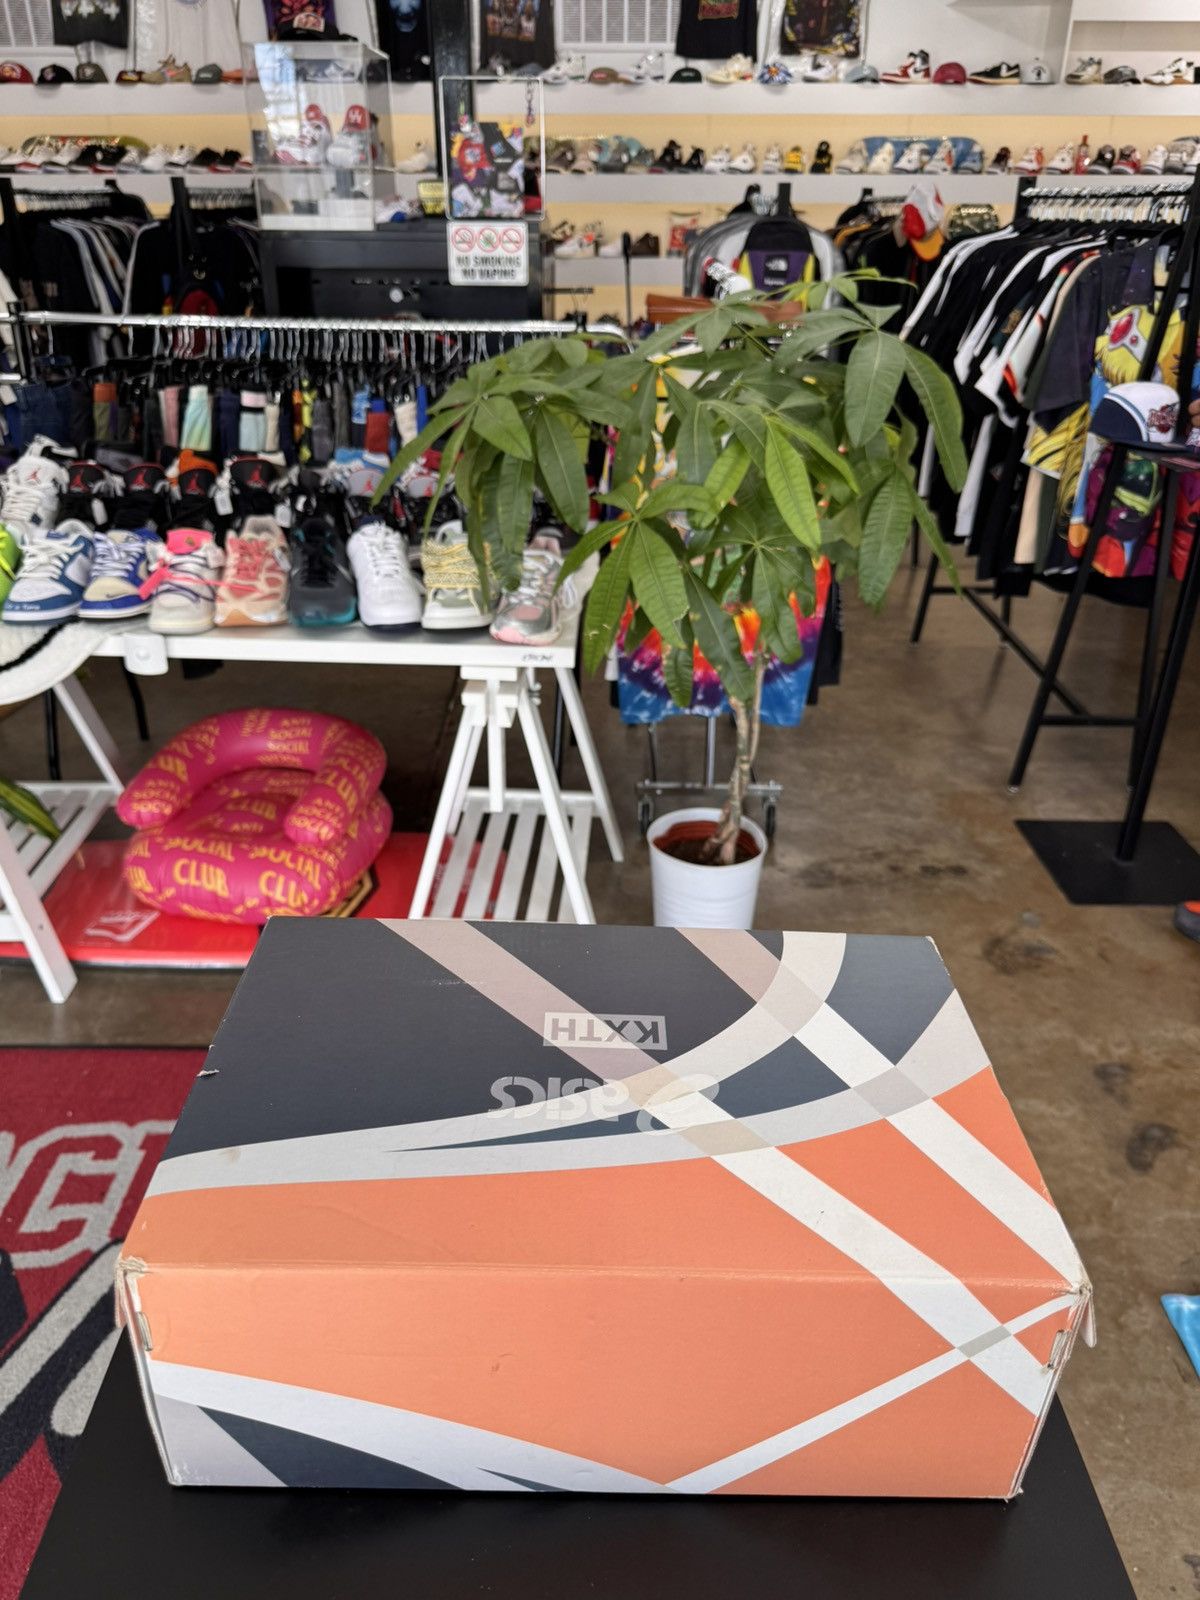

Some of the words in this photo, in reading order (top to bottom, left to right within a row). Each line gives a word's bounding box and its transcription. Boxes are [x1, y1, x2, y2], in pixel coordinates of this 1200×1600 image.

[456, 256, 470, 267] NO
[473, 256, 521, 267] SMOKING
[462, 269, 477, 280] NO
[173, 857, 230, 898] CLUB
[488, 1075, 629, 1122] asics
